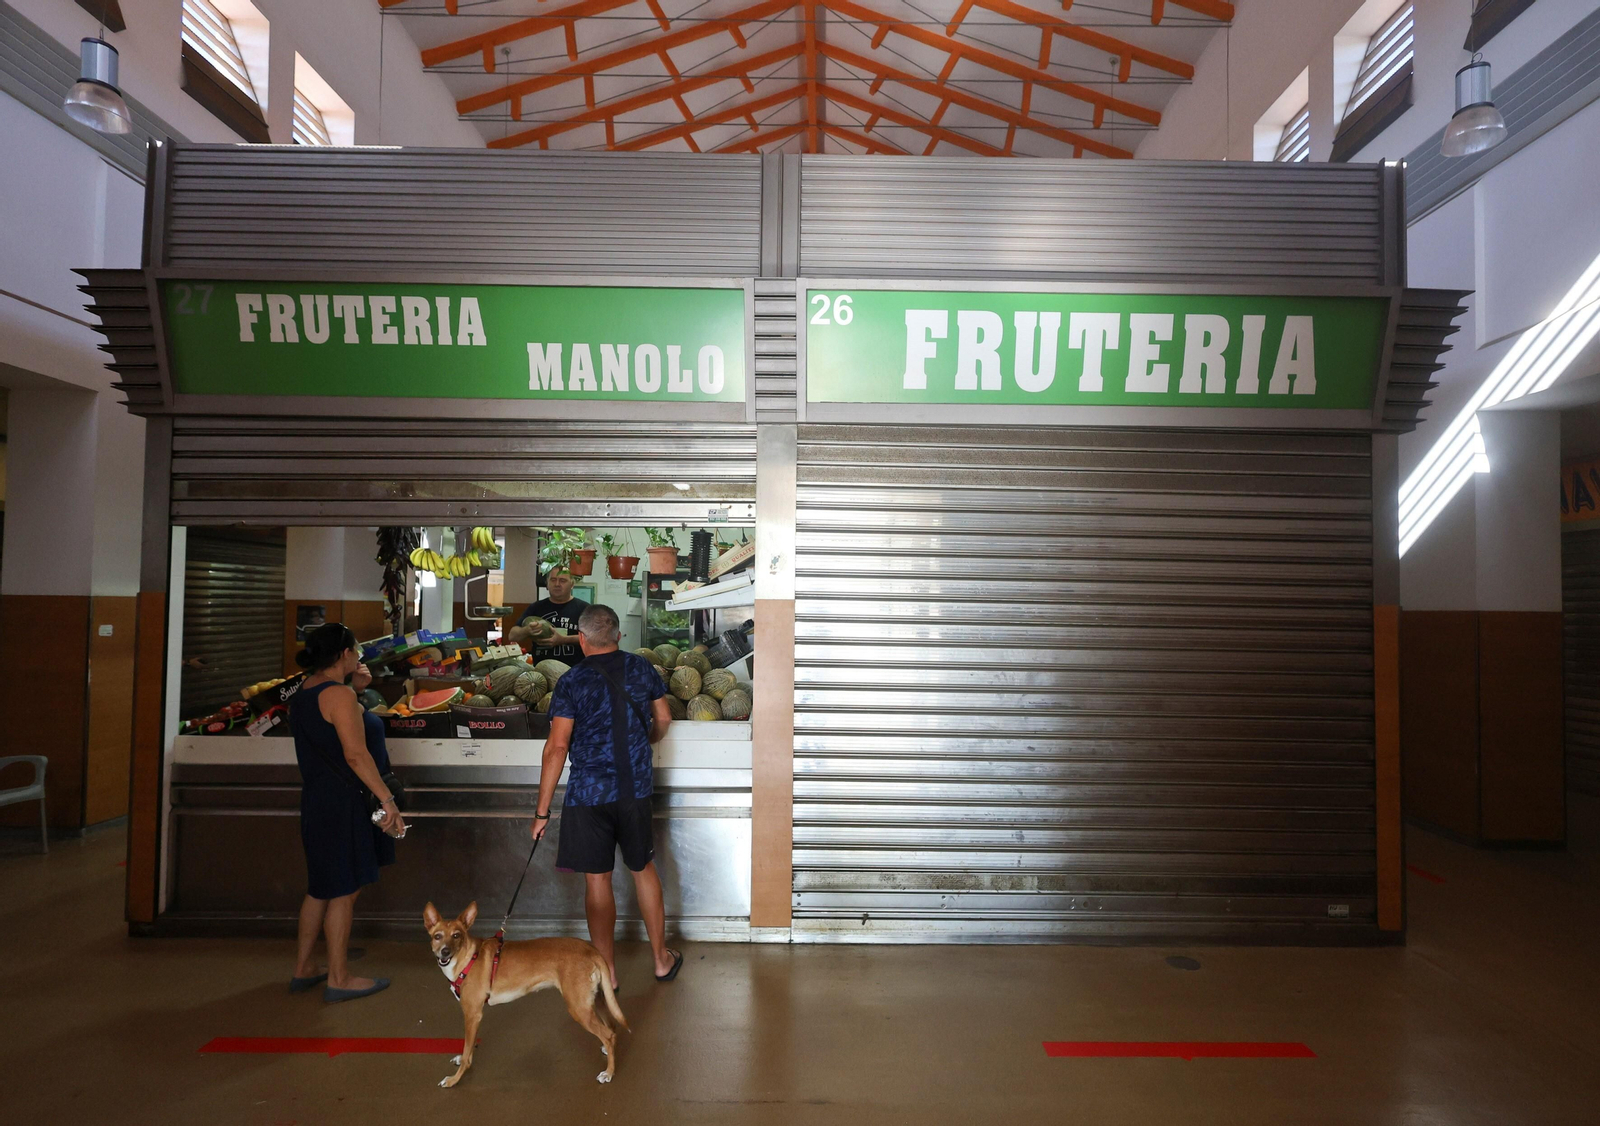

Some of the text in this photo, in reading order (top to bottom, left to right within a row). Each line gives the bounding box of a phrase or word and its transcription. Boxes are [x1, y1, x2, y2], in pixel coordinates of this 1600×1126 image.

[173, 283, 214, 315] 27
[810, 294, 854, 326] 26
[235, 293, 488, 347] FRUTERIA
[526, 342, 725, 395] MANOLO
[902, 309, 1318, 396] FRUTERIA
[390, 718, 427, 729] BOLLO
[468, 720, 506, 730] BOLLO
